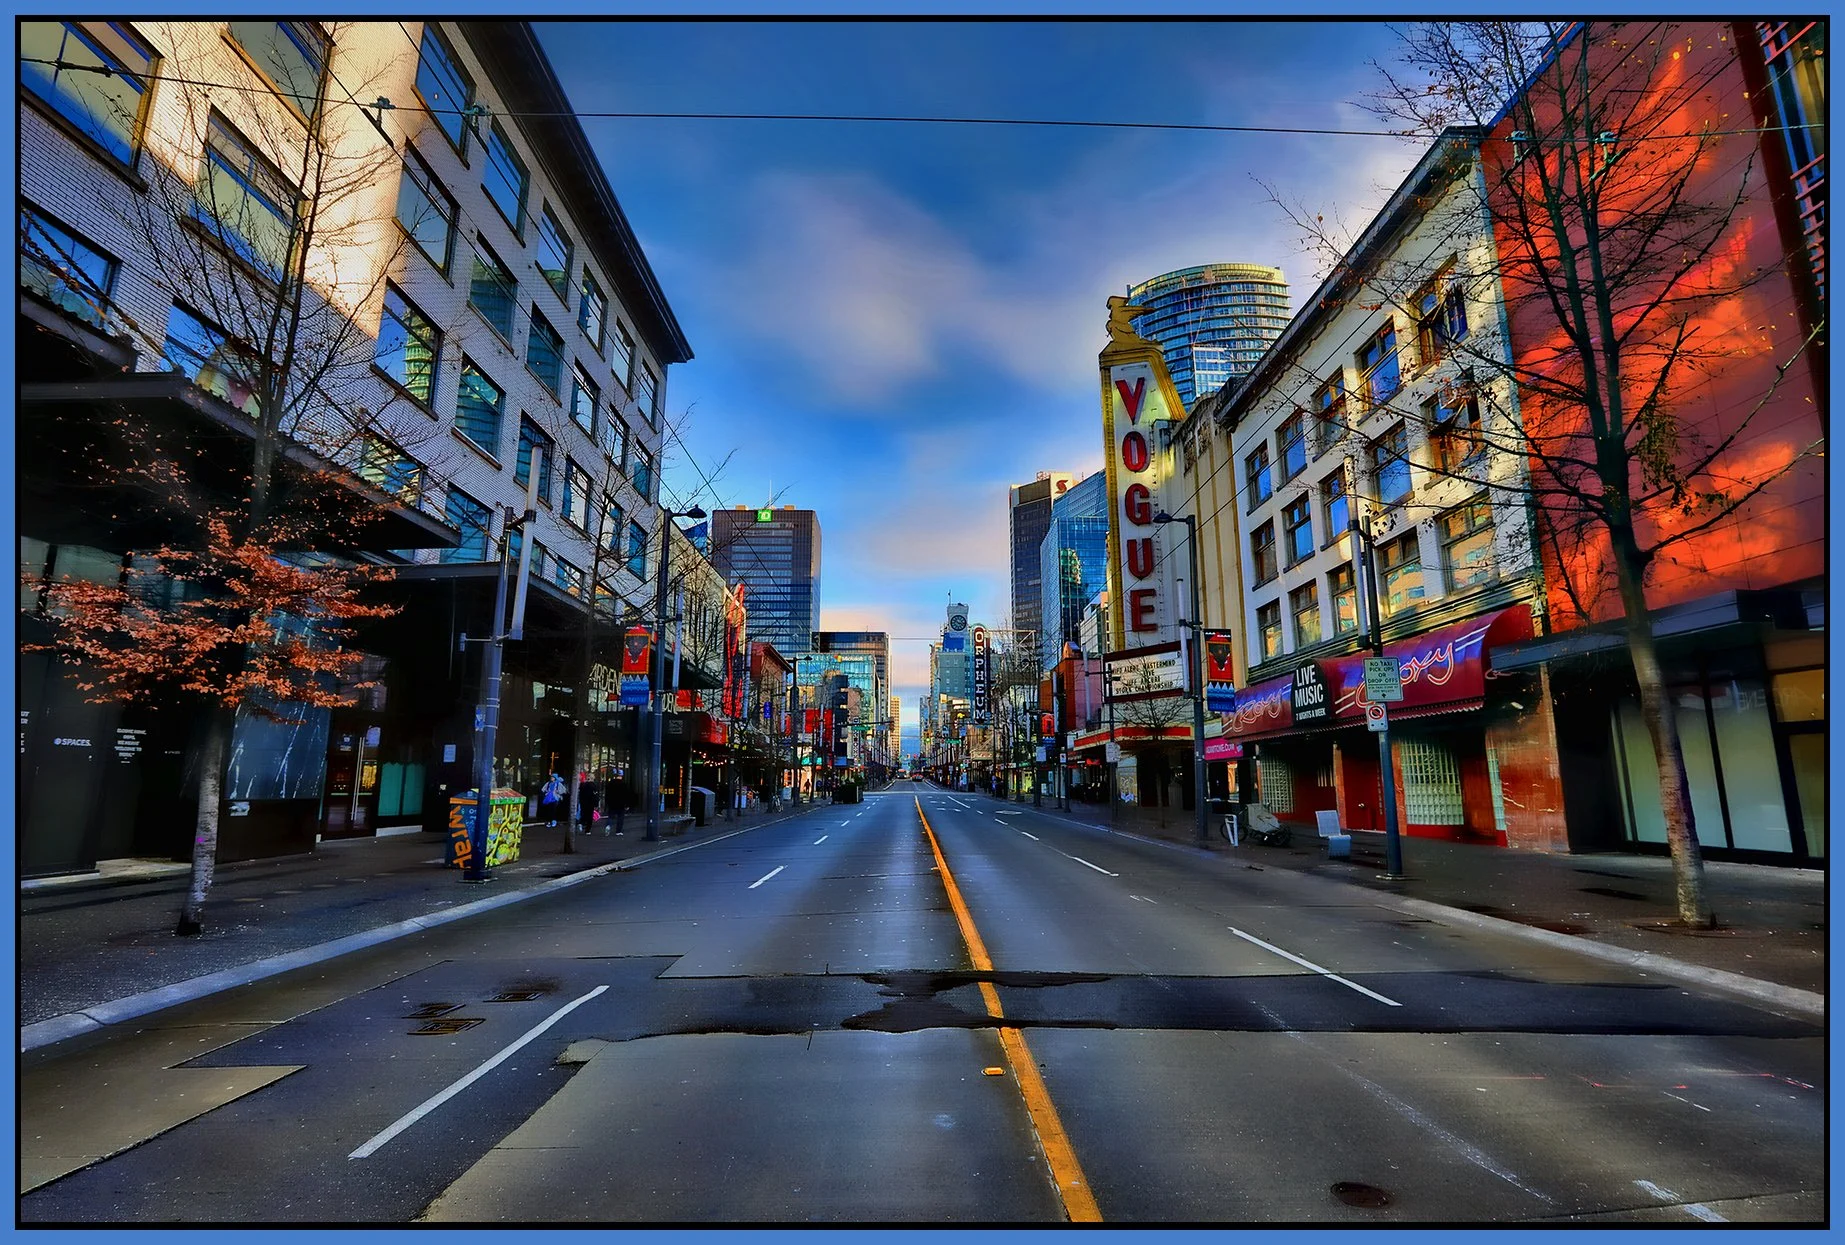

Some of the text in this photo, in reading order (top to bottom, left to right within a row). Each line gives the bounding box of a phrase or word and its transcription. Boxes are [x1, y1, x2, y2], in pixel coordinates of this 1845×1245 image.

[1115, 377, 1158, 632] VOGUE
[587, 661, 623, 696] ARDEN
[975, 631, 984, 719] ORPHEUM
[1296, 664, 1316, 687] LIVE
[1232, 688, 1282, 733] Roxy
[1295, 683, 1324, 708] MUSIC
[1315, 707, 1326, 717] WEEK
